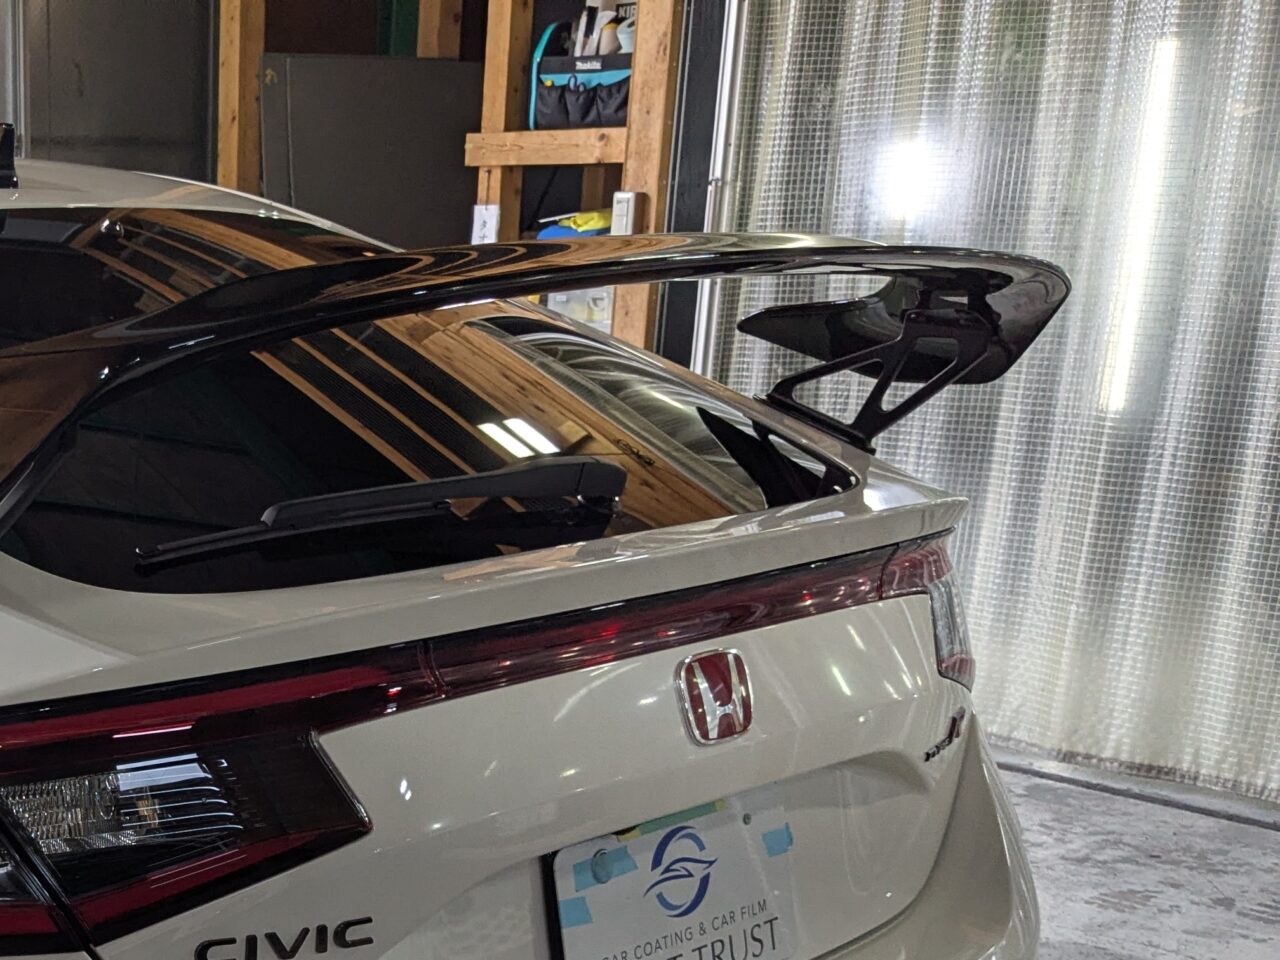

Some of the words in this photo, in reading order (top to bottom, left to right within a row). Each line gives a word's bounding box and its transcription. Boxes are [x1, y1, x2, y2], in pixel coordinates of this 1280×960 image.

[633, 926, 694, 960] COATING
[698, 921, 708, 936] &
[711, 910, 736, 931] CAR
[740, 899, 768, 922] FILM
